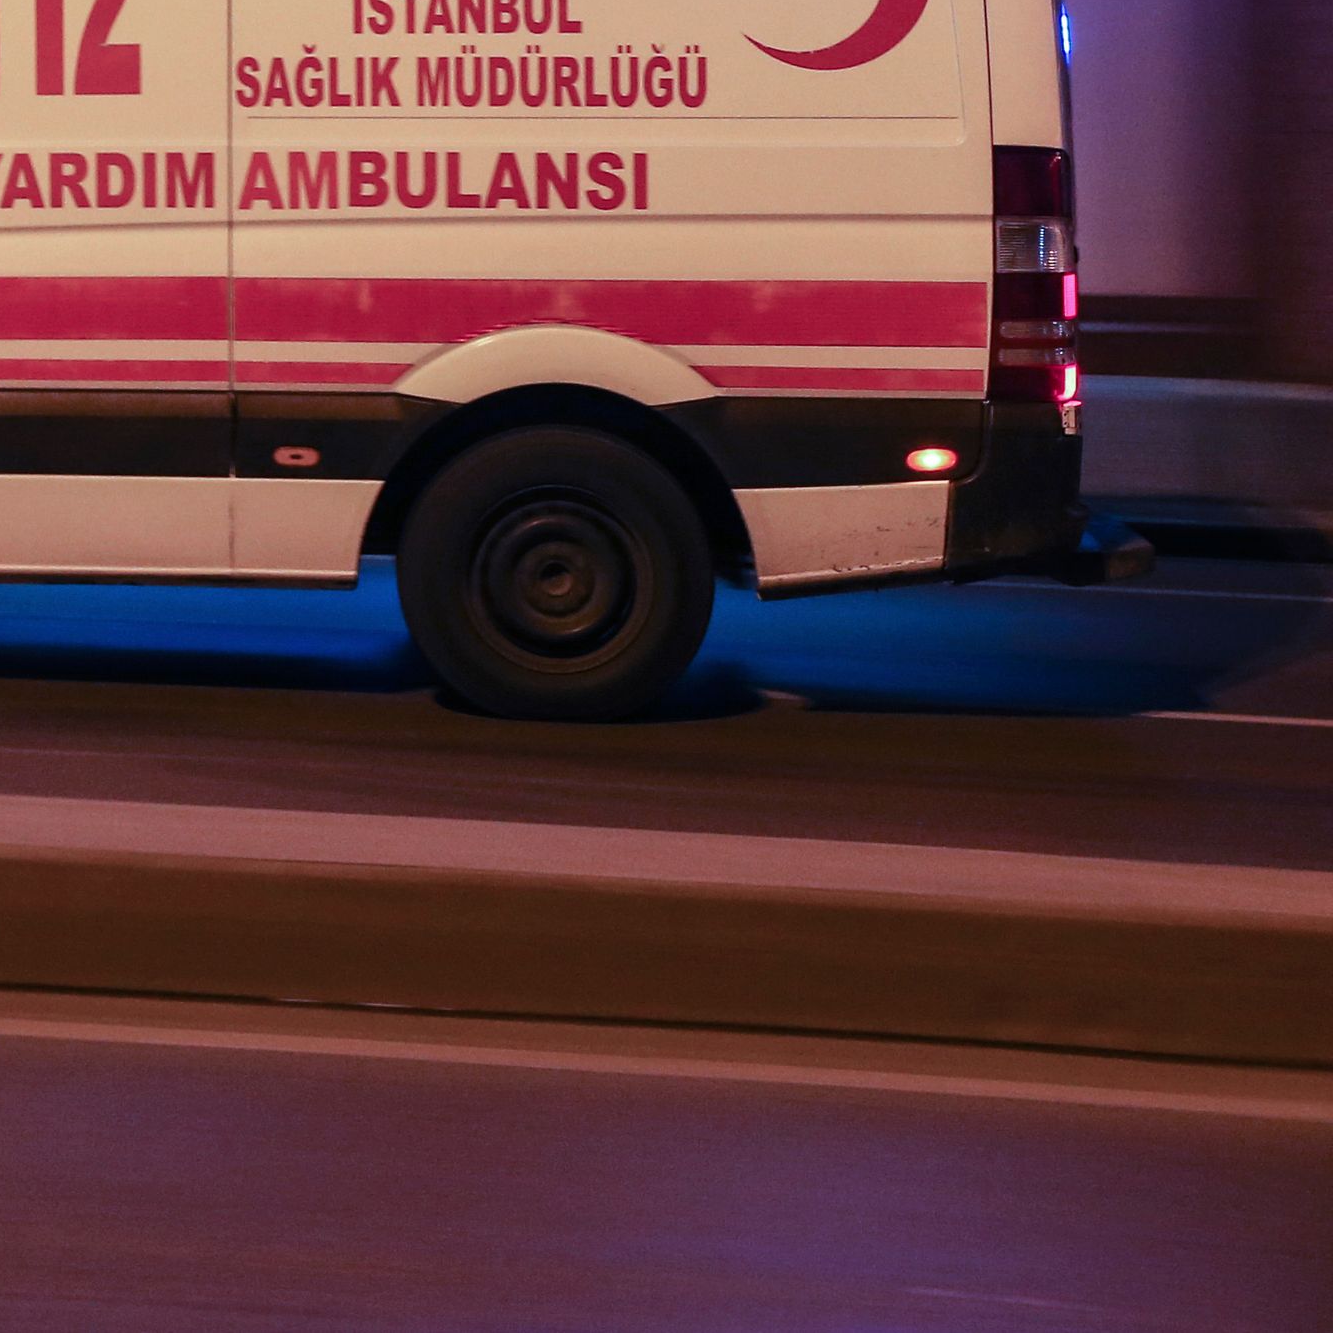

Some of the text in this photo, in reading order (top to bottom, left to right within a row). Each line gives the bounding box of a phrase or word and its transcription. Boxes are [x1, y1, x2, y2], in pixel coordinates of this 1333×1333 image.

[235, 44, 708, 109] SAĞLIK MÜDÜRLÜĞÜ
[238, 150, 650, 211] AMBULANSI
